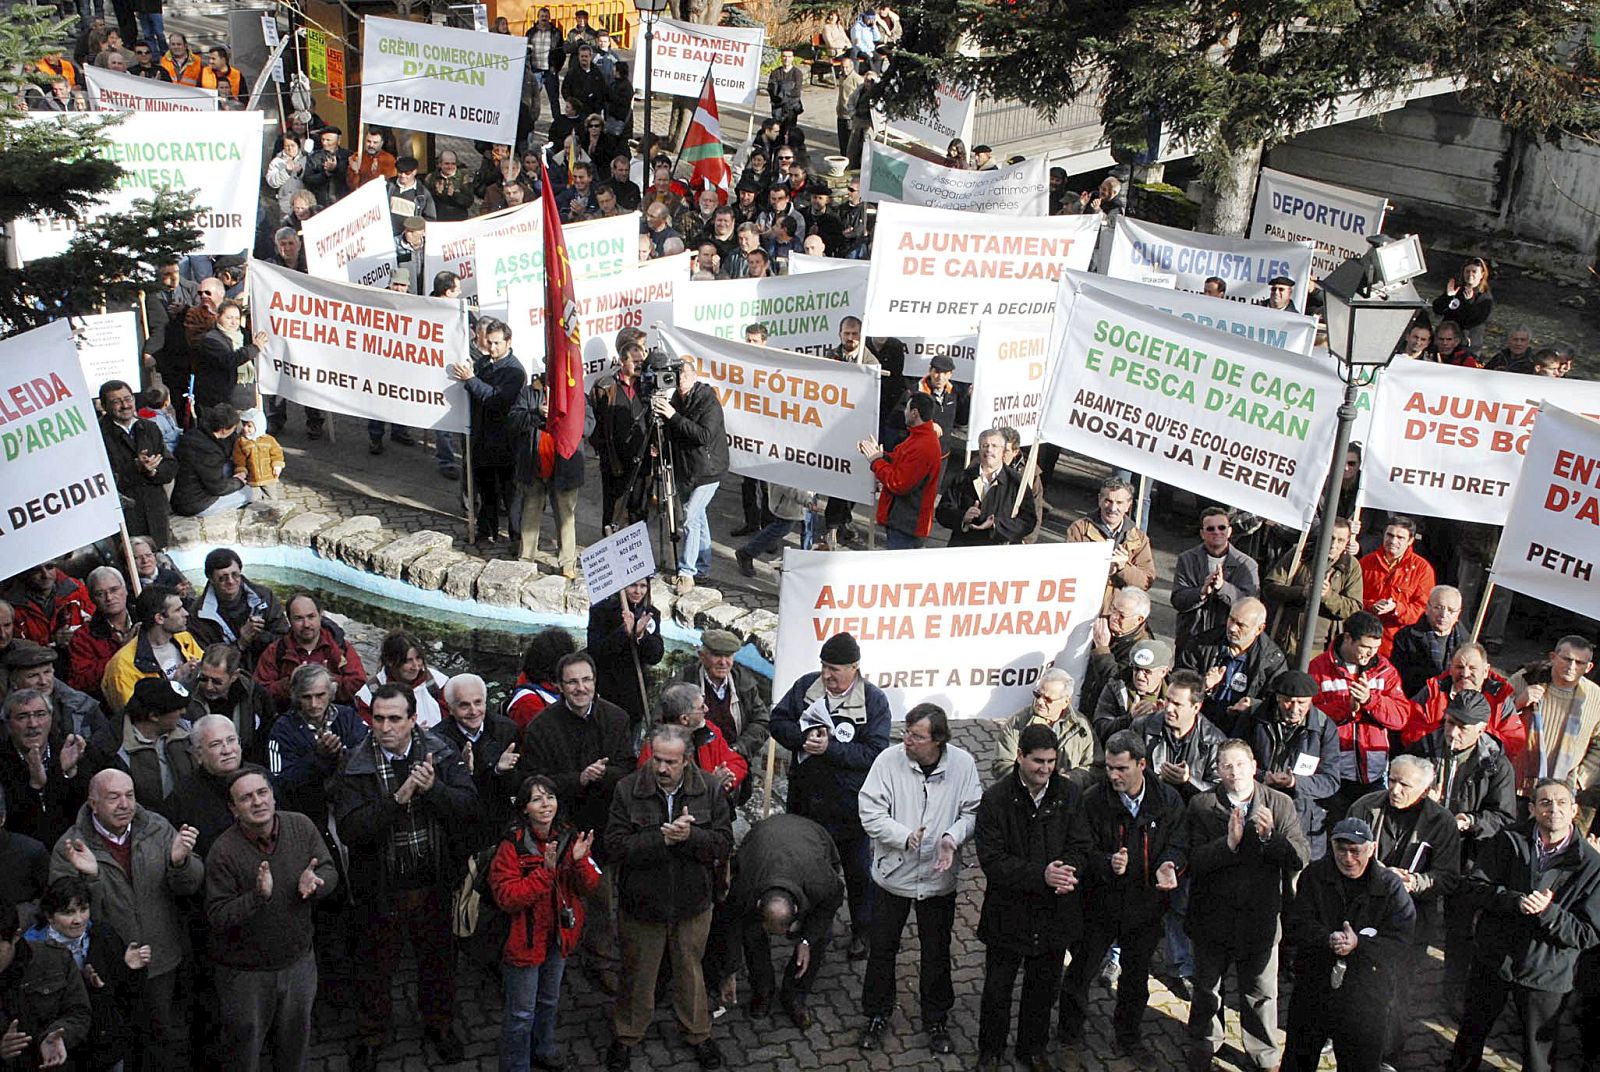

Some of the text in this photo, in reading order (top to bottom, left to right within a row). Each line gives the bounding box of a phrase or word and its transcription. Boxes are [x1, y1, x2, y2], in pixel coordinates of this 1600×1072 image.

[379, 37, 509, 71] GRÈMI COMERÇANTS
[653, 31, 750, 53] AJUNTAMENT
[657, 45, 745, 67] DE BAUSEN
[403, 60, 485, 87] D'ARAN
[650, 68, 671, 80] ETH
[673, 71, 698, 83] DRET
[100, 88, 142, 110] ENTITAT
[377, 94, 500, 126] PETH DRET A DECIDIR
[117, 168, 186, 188] ANESA
[911, 178, 972, 200] Sauvegarde
[989, 183, 1044, 196] Patrimoine
[1014, 170, 1023, 180] la
[178, 213, 243, 229] ECIDIR
[1272, 191, 1366, 235] DEPORTUR
[316, 226, 345, 258] ENTITAT
[898, 231, 1075, 257] AJUNTAMENT
[1264, 223, 1286, 239] PARA
[336, 249, 346, 269] DE
[362, 262, 391, 286] DECIDIR
[459, 260, 473, 280] DE
[902, 257, 1064, 280] DE CANEJAN
[1131, 240, 1290, 283] CLUB CICLISTA LES
[597, 280, 673, 313] MUNICIPAU
[694, 289, 850, 322] UNIO DEMOCRÀTICA
[888, 299, 1056, 315] PETH DRET A DECIDIR
[270, 291, 444, 343] AJUNTAMENT DE
[586, 308, 643, 337] TREDÒS
[270, 315, 444, 368] VIELHA E MIJARAN
[914, 343, 975, 361] DECIDIR
[273, 358, 446, 406] PETH DRET A DECIDIR
[583, 357, 606, 376] RET
[1093, 319, 1207, 374] SOCIETAT
[1211, 357, 1245, 388] DE
[1250, 371, 1316, 413] CAÇA
[0, 372, 72, 421] LEIDA
[753, 368, 856, 409] FÓTBOL
[1085, 348, 1310, 442] E PESCA D'ARAN
[713, 386, 823, 428] VIELHA
[1403, 391, 1538, 428] AJUNTA
[1, 405, 88, 462] D'ARAN
[1073, 388, 1297, 477] ABANTES QU'ES ECOLOGISTES
[1404, 419, 1480, 448] D'ES
[768, 443, 779, 459] A
[785, 446, 851, 475] DECIDIR
[1069, 408, 1291, 499] NOSATI JA I ÈREM
[1389, 466, 1510, 497] PETH DRET
[8, 472, 110, 531] DECIDIR
[1526, 541, 1593, 582] PETH
[814, 577, 1077, 609] AJUNTAMENT DE
[813, 609, 1072, 641] VIELHA E MIJARAN
[878, 669, 939, 689] DRET
[946, 668, 961, 687] A
